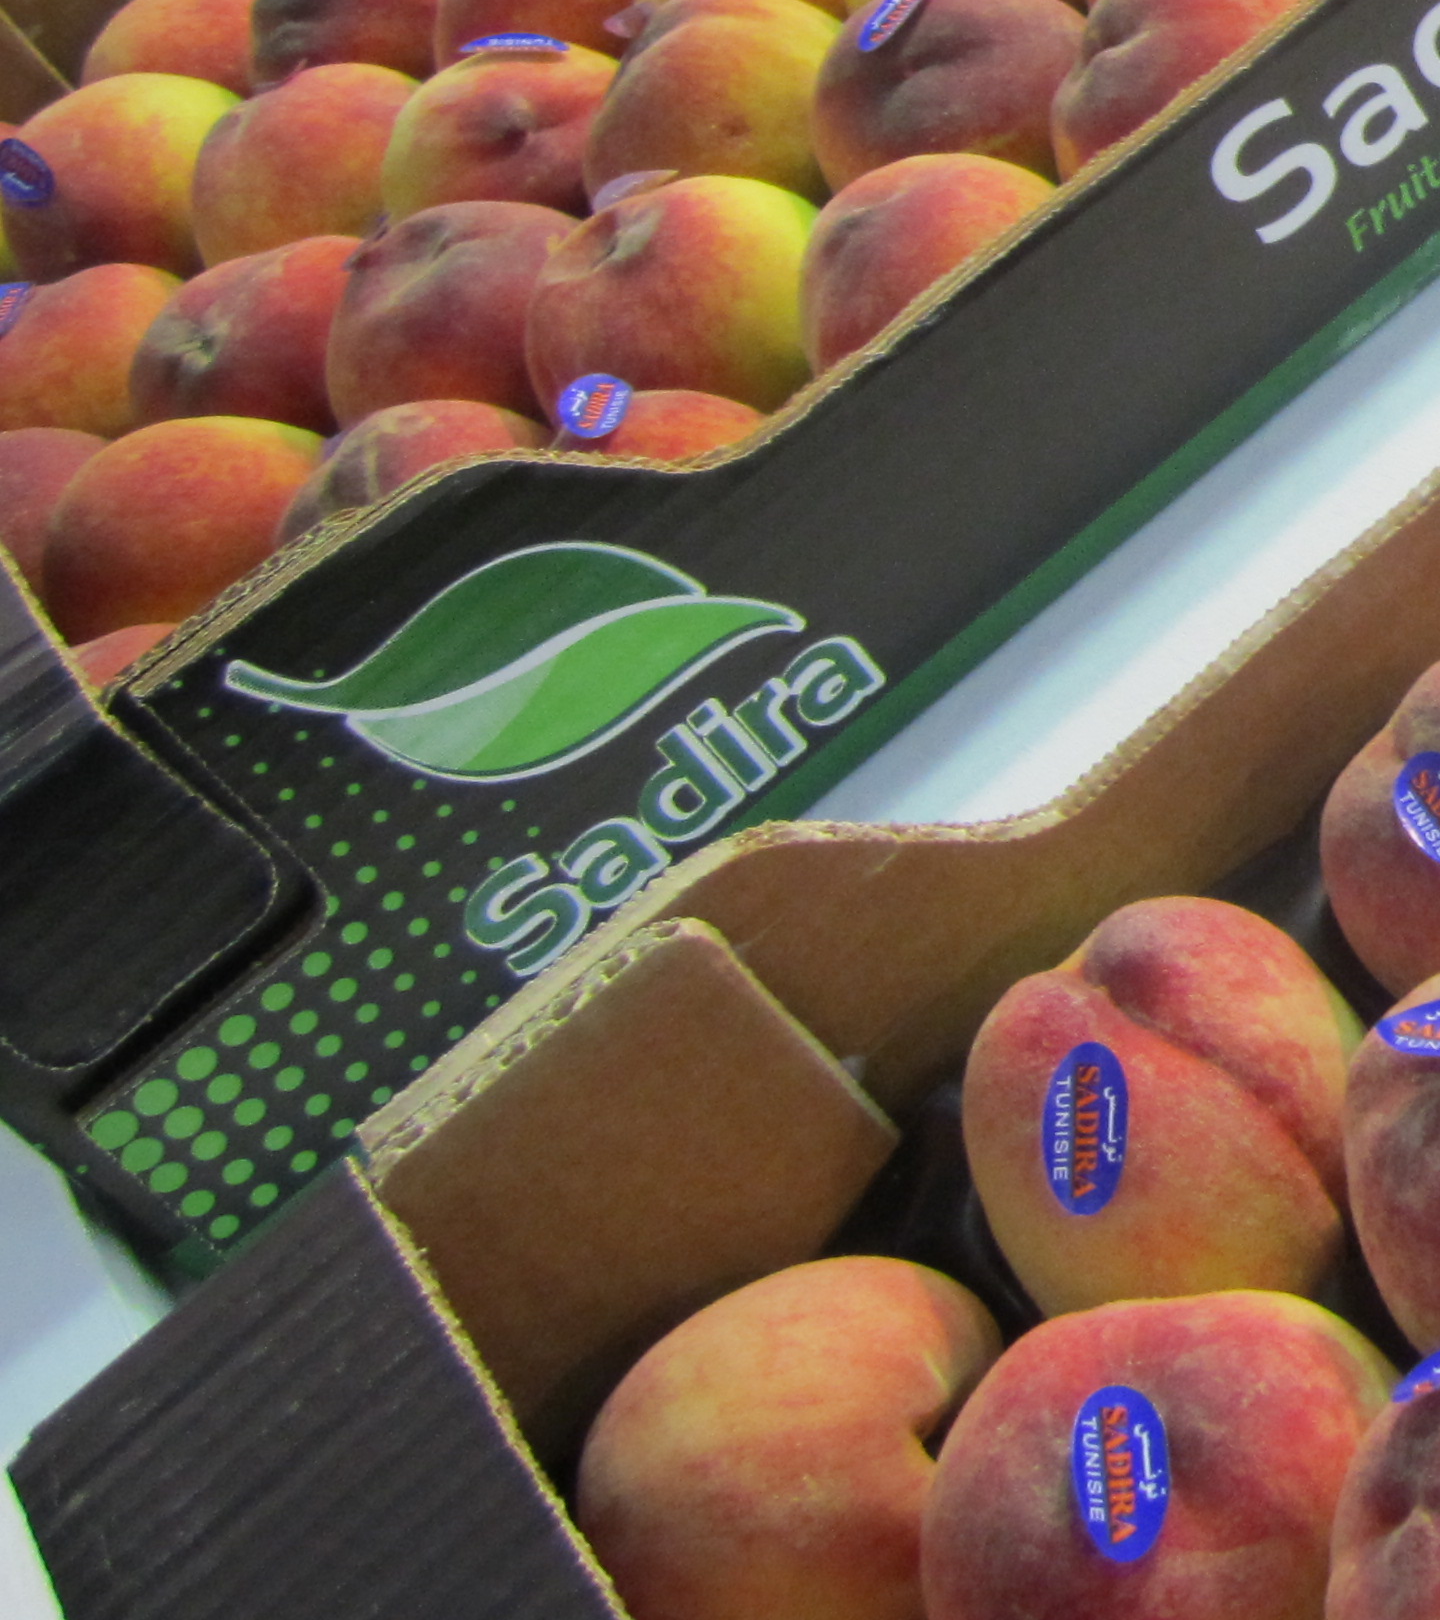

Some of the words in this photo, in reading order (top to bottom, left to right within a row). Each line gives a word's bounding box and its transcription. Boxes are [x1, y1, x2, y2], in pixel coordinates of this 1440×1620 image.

[578, 383, 616, 428] SADIRA
[601, 389, 630, 429] TUNISIE
[465, 635, 886, 978] Sadira
[1053, 1076, 1072, 1181] TUNISIE
[1073, 1065, 1100, 1198] SADIRA
[1082, 1417, 1105, 1522] TUNISIE
[1102, 1405, 1137, 1544] SADIRA
